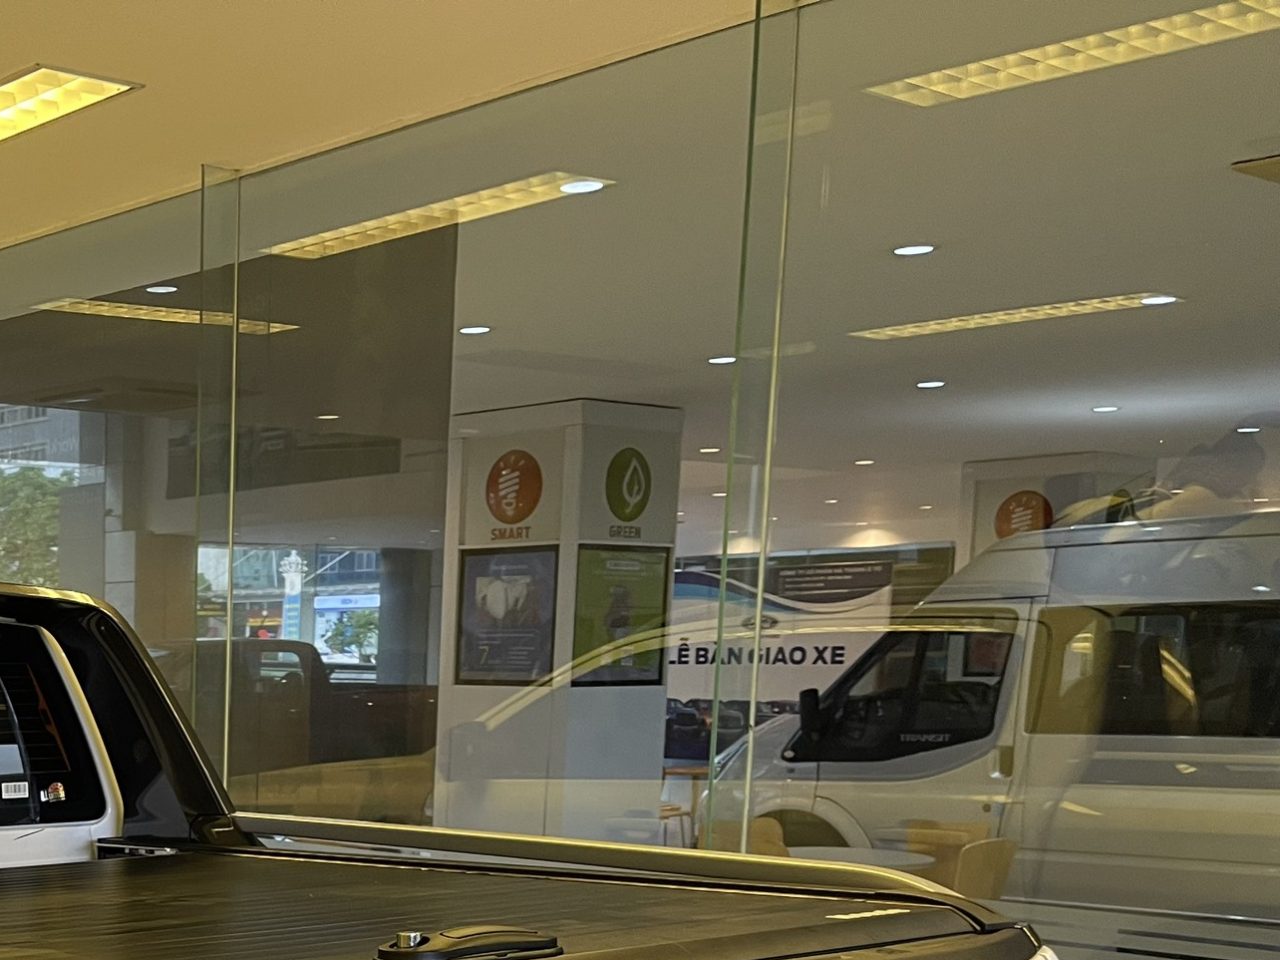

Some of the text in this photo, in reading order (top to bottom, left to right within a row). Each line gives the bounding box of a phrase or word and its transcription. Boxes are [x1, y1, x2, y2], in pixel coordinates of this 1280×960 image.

[491, 526, 531, 541] SMART
[609, 525, 641, 539] GREEN
[748, 645, 807, 665] GIAO
[812, 645, 846, 665] XE
[900, 733, 951, 742] TRANSIT
